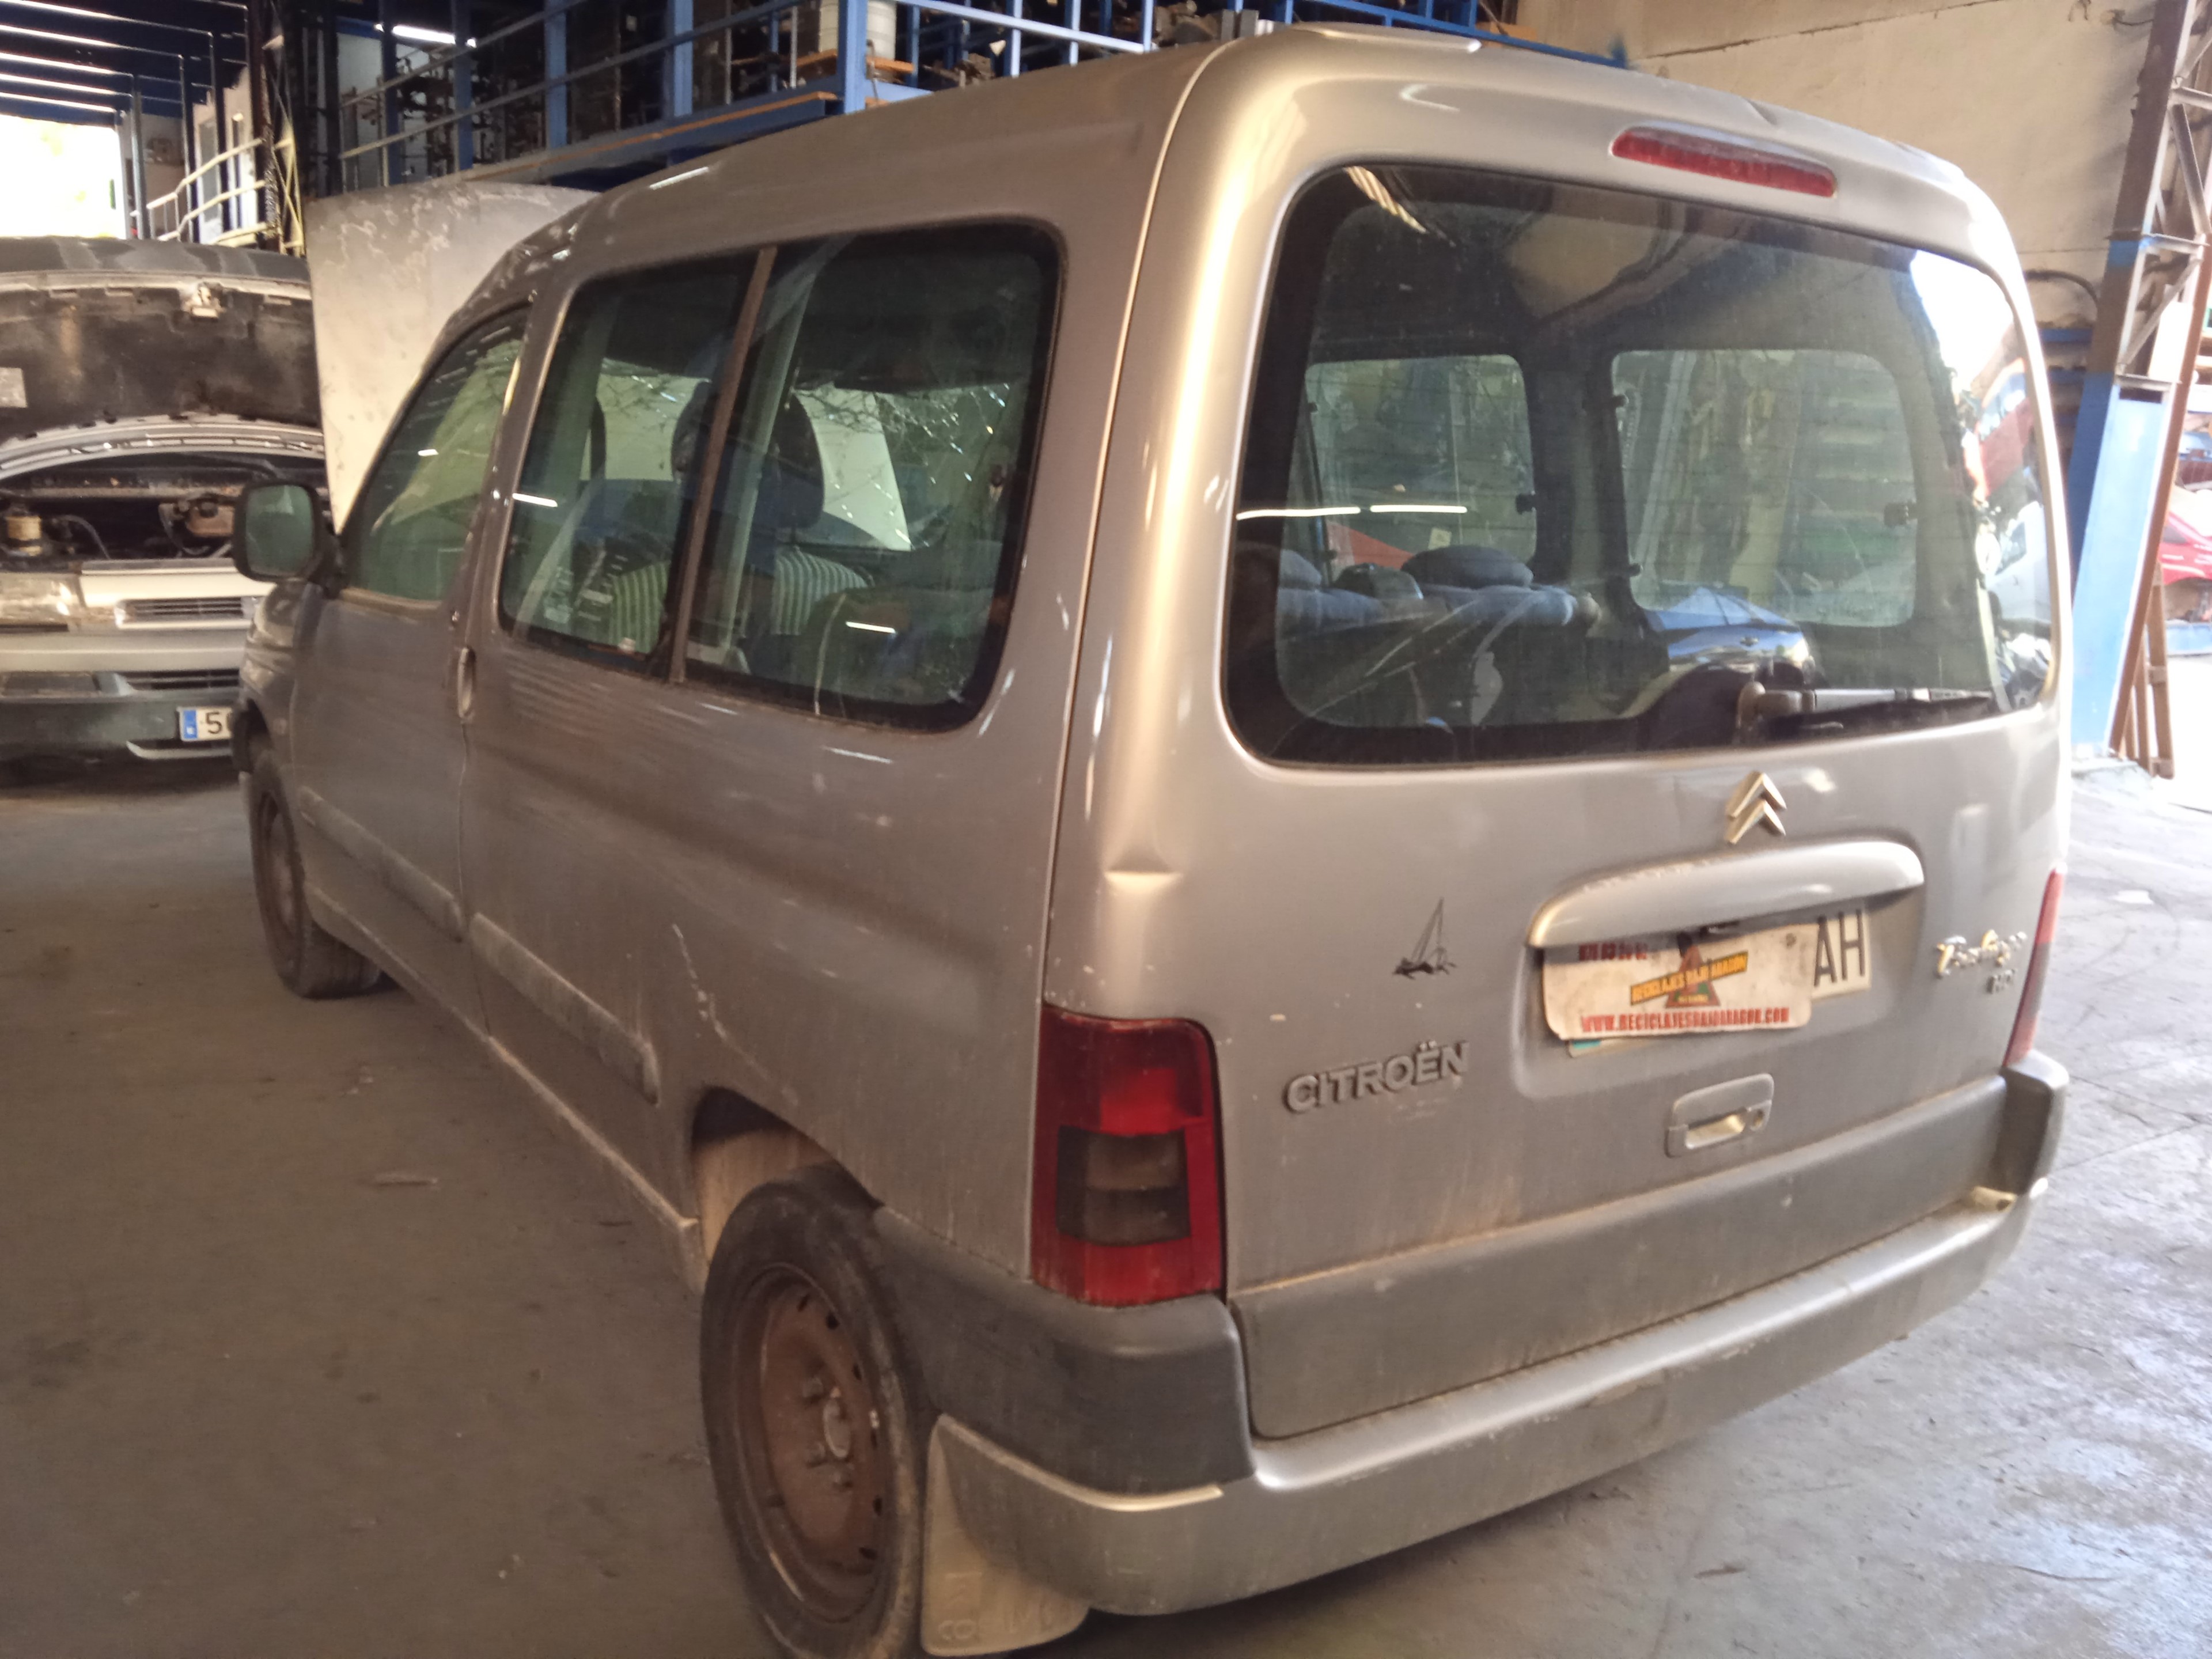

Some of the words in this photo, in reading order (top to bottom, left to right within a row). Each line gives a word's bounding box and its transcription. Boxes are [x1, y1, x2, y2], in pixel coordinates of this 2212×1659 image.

[205, 711, 232, 734] 5
[1813, 909, 1866, 987] AH
[1282, 1039, 1470, 1114] CITROËN
